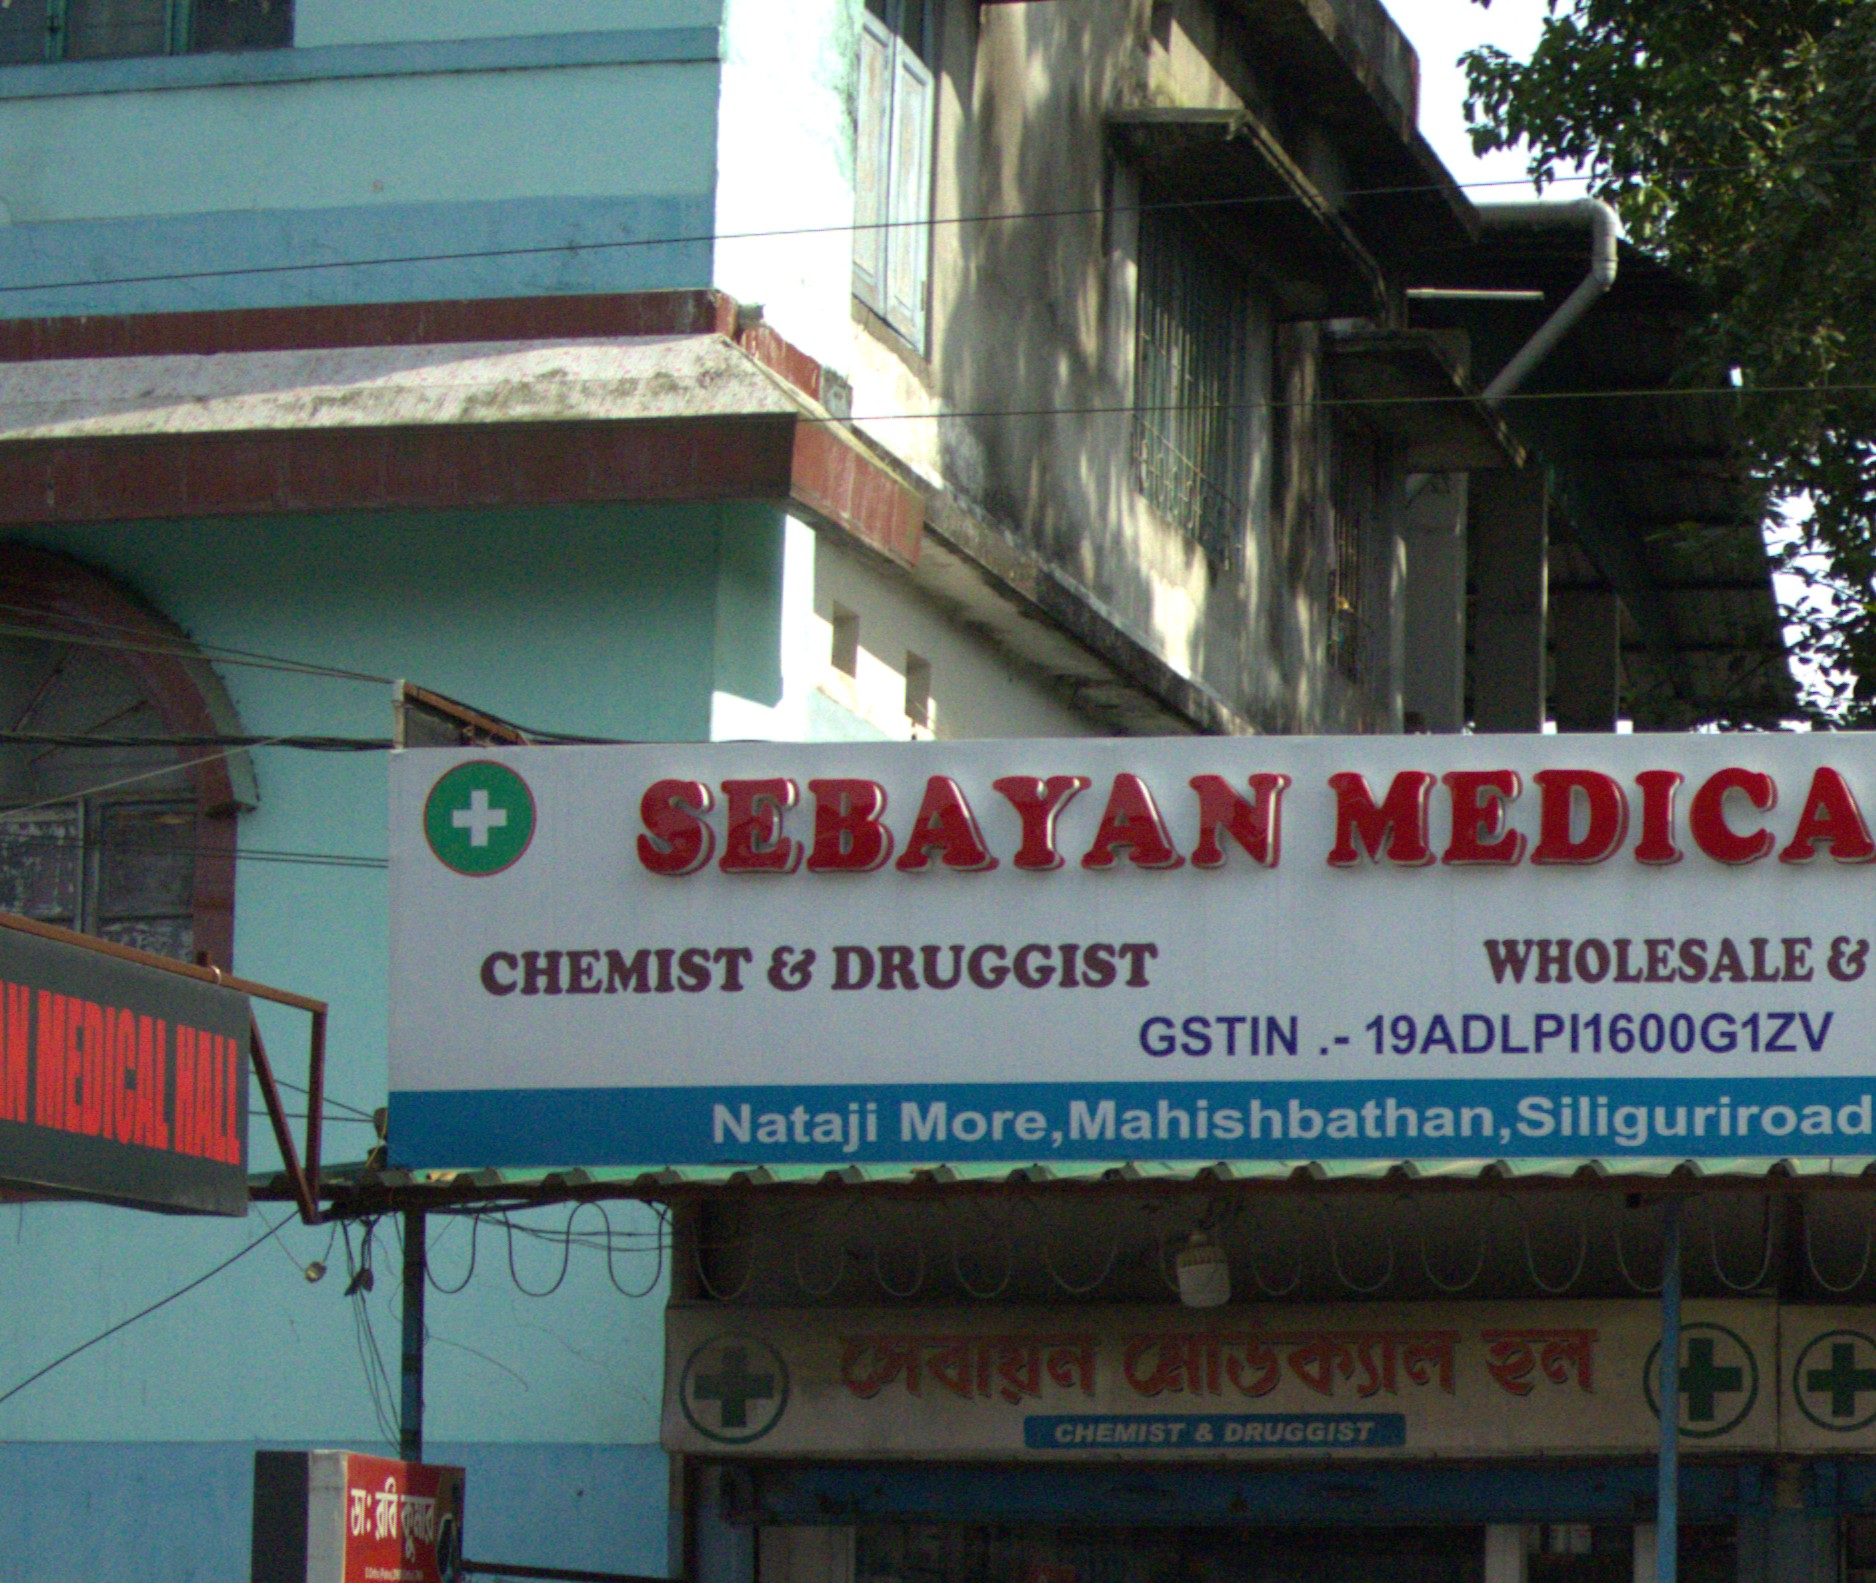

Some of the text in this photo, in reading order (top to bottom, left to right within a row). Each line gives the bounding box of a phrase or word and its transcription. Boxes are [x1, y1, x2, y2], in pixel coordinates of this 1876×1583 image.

[636, 773, 1291, 875] SEBAYAN
[480, 942, 1159, 996] CHEMIST & DRUGGIST
[1483, 936, 1813, 985] WHOLESALE
[1827, 937, 1870, 981] &
[1140, 1014, 1300, 1058] GSTIN
[35, 989, 240, 1165] MEDICAL HALL
[712, 1102, 878, 1153] Nataji
[1482, 1328, 1598, 1396] হল
[1055, 1420, 1376, 1443] CHEMIST & DRUGGIST
